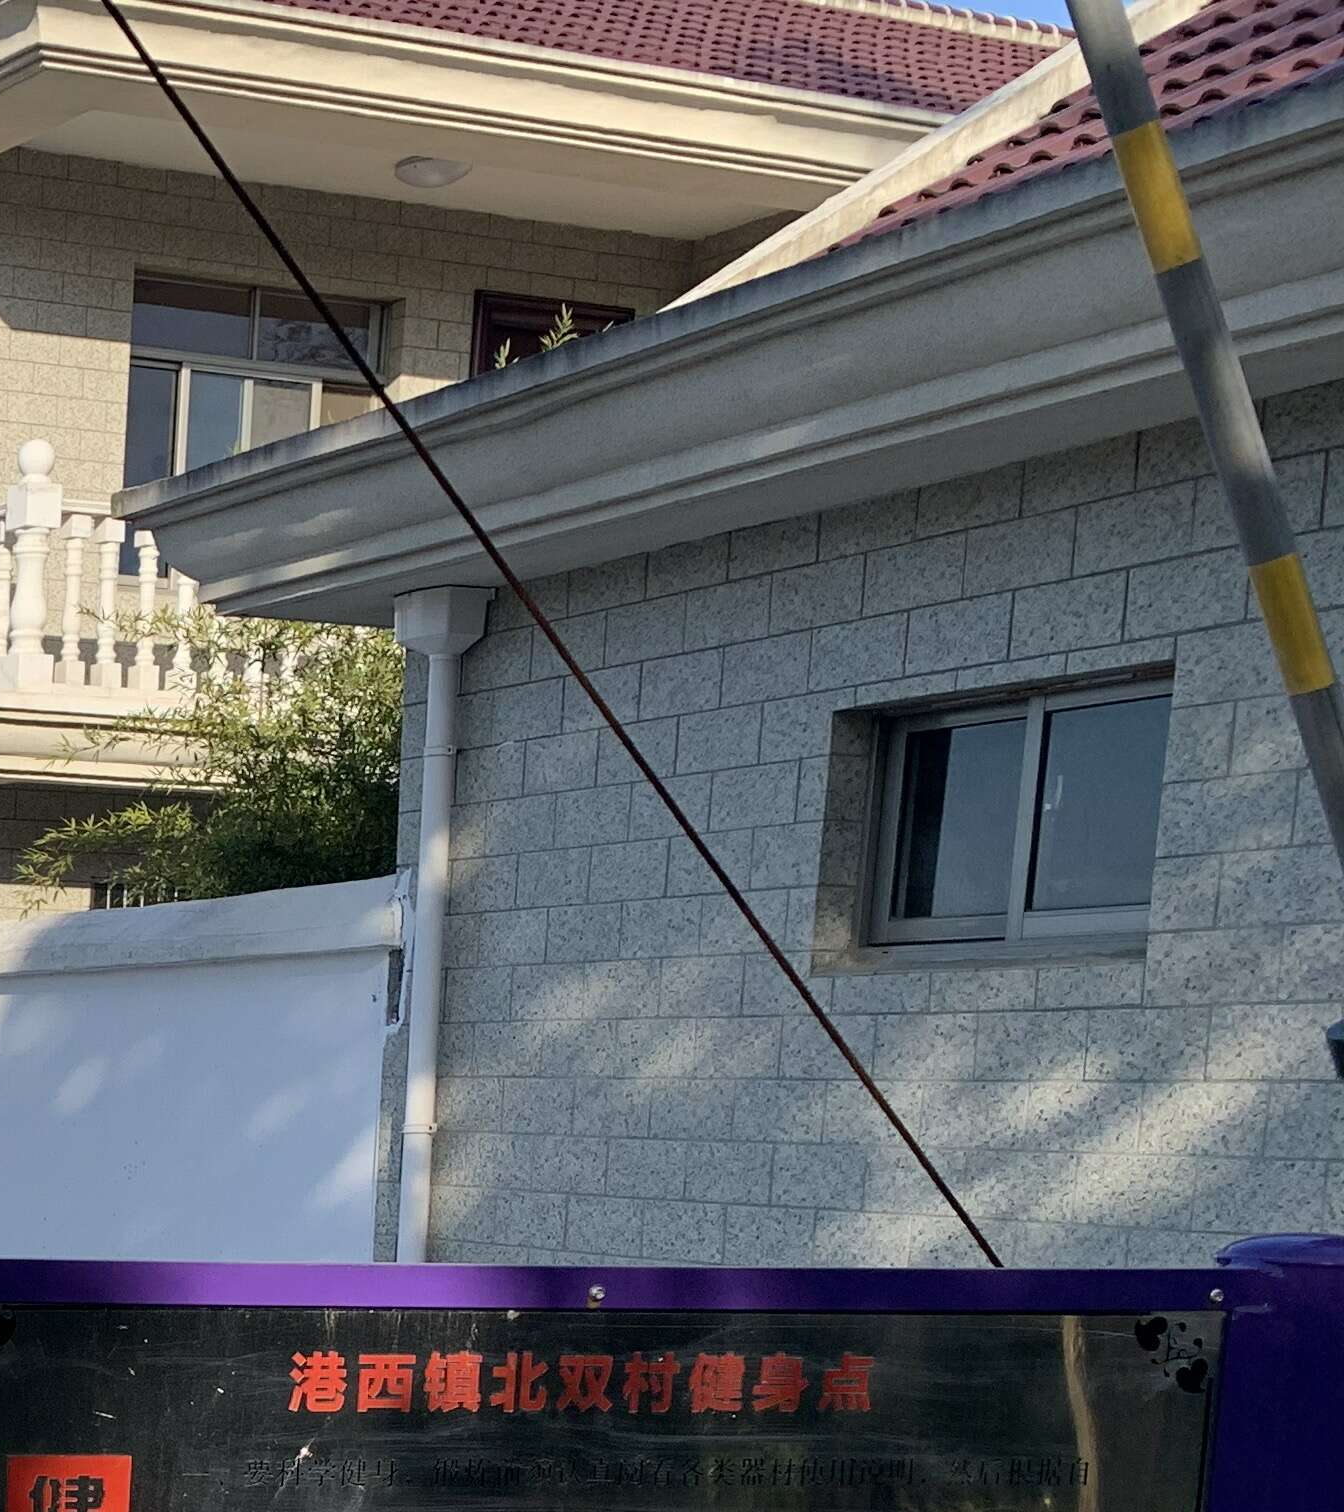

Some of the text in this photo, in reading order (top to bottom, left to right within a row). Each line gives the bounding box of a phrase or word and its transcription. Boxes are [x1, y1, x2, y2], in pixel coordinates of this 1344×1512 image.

[287, 1350, 875, 1414] 港西镇北双村健身点
